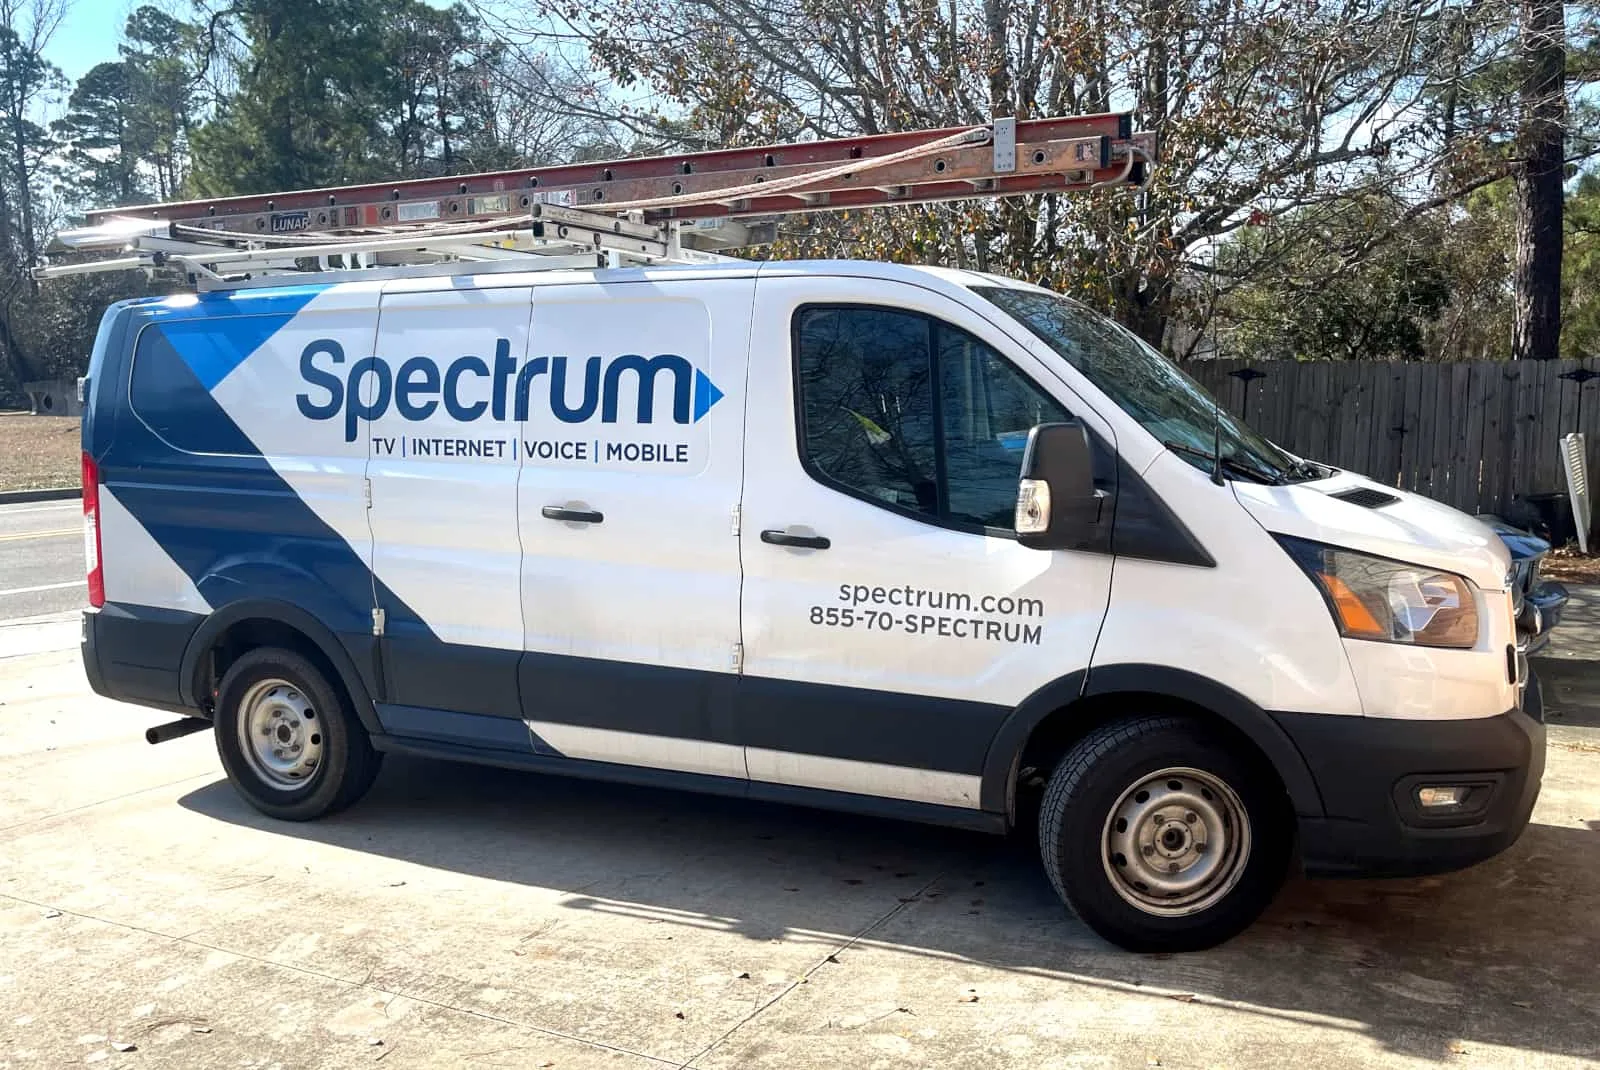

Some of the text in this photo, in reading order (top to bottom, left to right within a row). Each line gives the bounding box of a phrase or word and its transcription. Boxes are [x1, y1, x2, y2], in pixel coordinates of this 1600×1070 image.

[296, 338, 693, 442] Spectrum
[372, 438, 689, 463] TV INTERNET VOICE MOBILE
[839, 584, 1044, 617] spectrum.com
[810, 606, 1042, 645] 855-70-SPECTRUM
